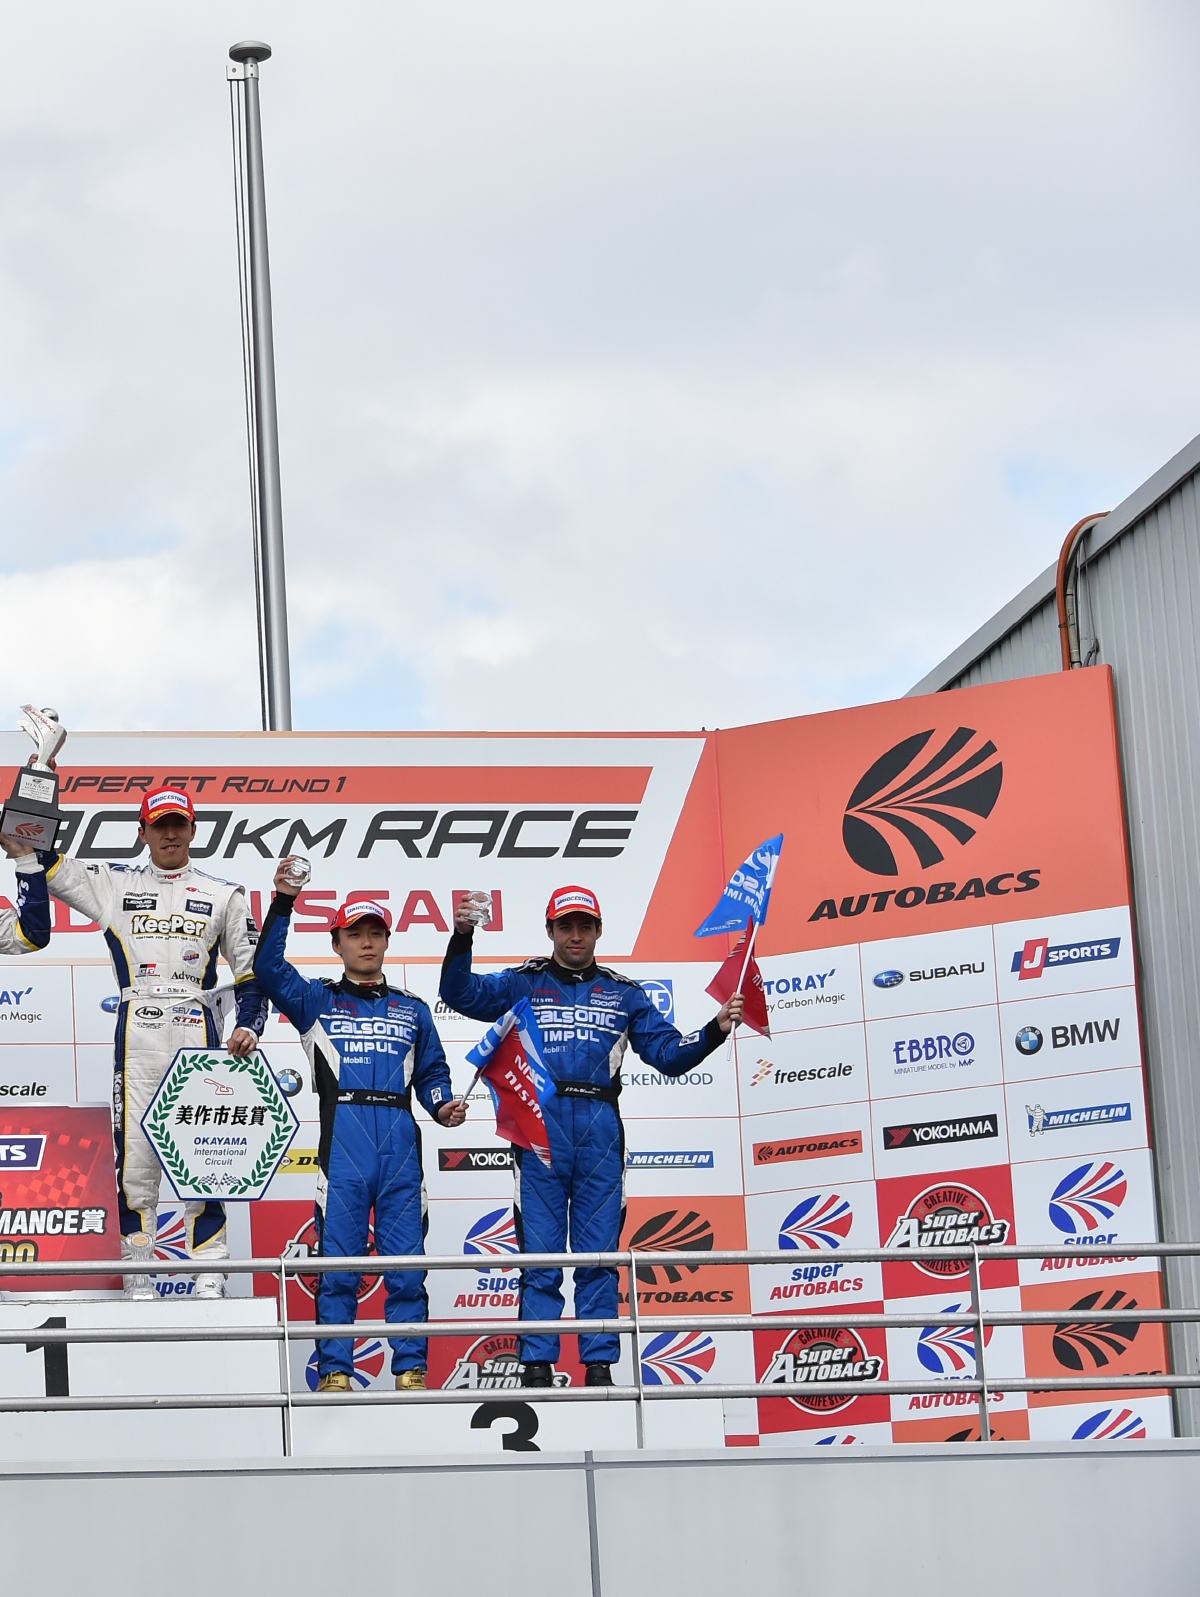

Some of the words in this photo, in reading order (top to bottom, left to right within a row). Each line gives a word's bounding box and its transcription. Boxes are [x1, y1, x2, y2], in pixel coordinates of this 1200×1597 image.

[337, 776, 347, 793] 1
[8, 833, 46, 844] AUTOBACS
[357, 810, 638, 859] RACE
[807, 869, 1041, 923] AUTOBACS
[132, 914, 206, 937] KeePer
[1048, 943, 1111, 962] SPORTS
[171, 971, 201, 985] Advox
[909, 962, 985, 982] SUBARU
[777, 994, 813, 1010] Carbon
[814, 991, 846, 1008] Magic
[9, 1011, 42, 1024] Magic
[139, 1006, 160, 1016] Arai
[544, 1028, 600, 1042] IMPUL
[1052, 1018, 1120, 1049] BMW
[345, 1041, 398, 1055] IMPUL
[893, 1031, 975, 1065] EBBRO
[774, 1062, 853, 1084] freescale
[894, 1064, 927, 1075] MINIATURE
[927, 1062, 949, 1071] MODEL
[949, 1061, 957, 1070] by
[175, 1105, 268, 1126] 美作市長賞
[1048, 1105, 1128, 1125] MICHELIN
[912, 1119, 995, 1142] YOKOHAMA
[194, 1137, 247, 1146] OKAYAMA
[775, 1137, 859, 1157] AUTOBACS
[194, 1148, 247, 1156] International
[631, 1154, 711, 1165] MICHELIN
[205, 1158, 233, 1166] Circuit
[923, 1191, 969, 1210] CREATIVE
[921, 1210, 979, 1230] Super
[770, 1277, 863, 1300] AUTOBACS
[26, 1316, 71, 1398] 1
[797, 1347, 853, 1366] Super
[762, 1354, 879, 1383] AUTOBACS
[470, 1402, 541, 1452] 3
